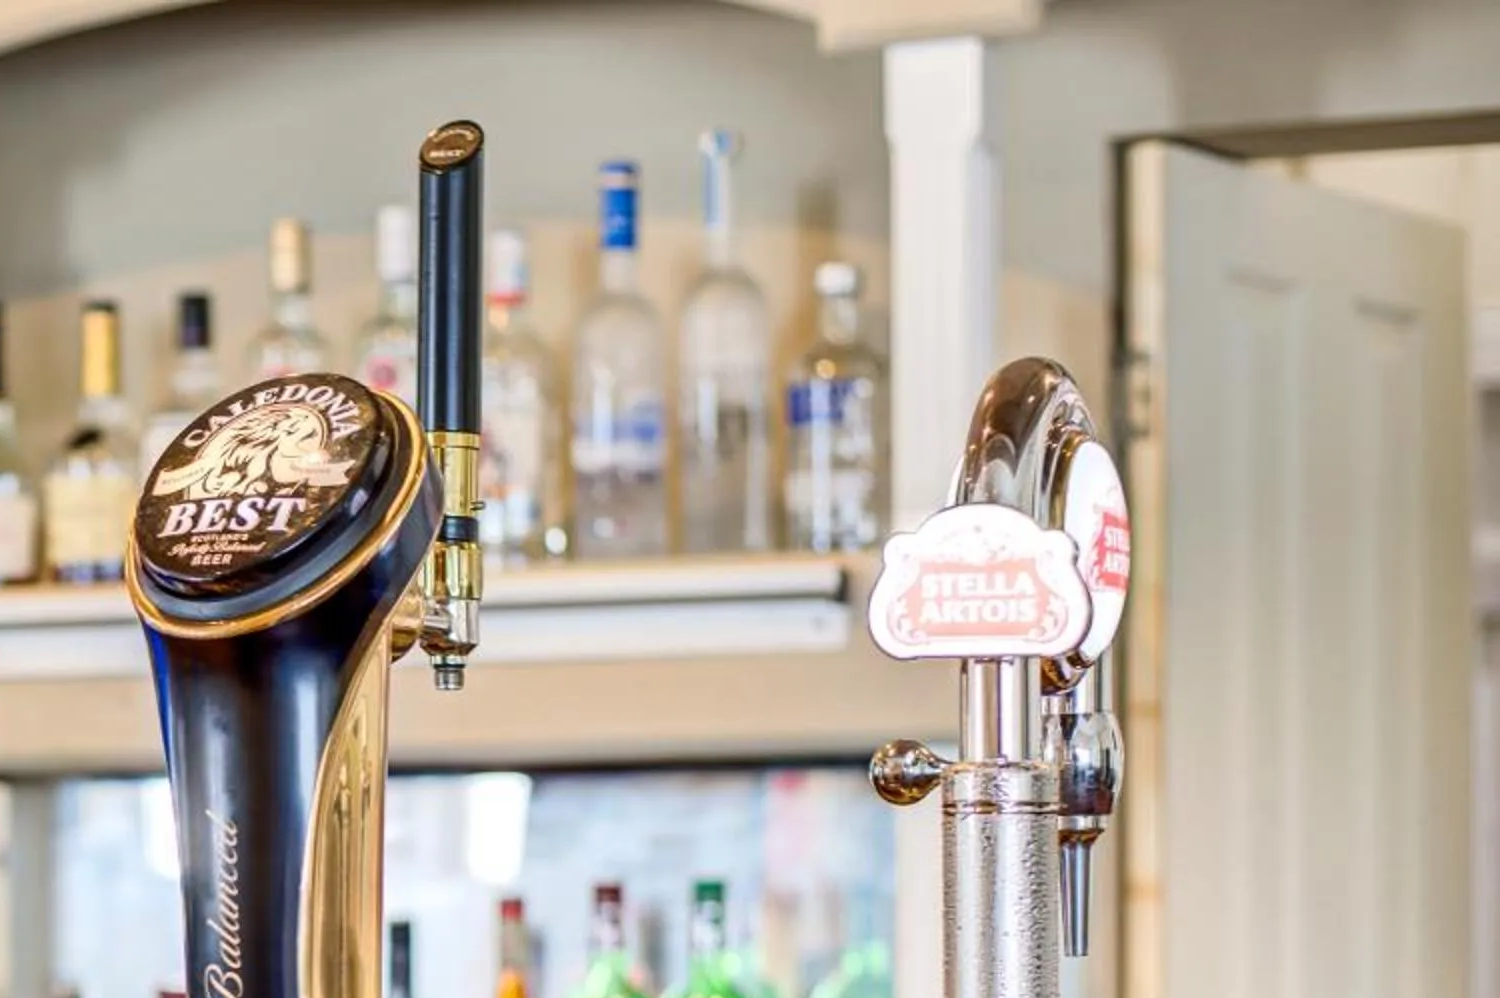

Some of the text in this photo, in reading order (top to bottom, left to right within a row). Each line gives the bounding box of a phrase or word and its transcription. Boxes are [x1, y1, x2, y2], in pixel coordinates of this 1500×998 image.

[184, 384, 362, 448] CALEDONIA
[156, 497, 306, 538] BEST
[920, 570, 1036, 598] STELLA
[919, 600, 1037, 624] ARTOIS
